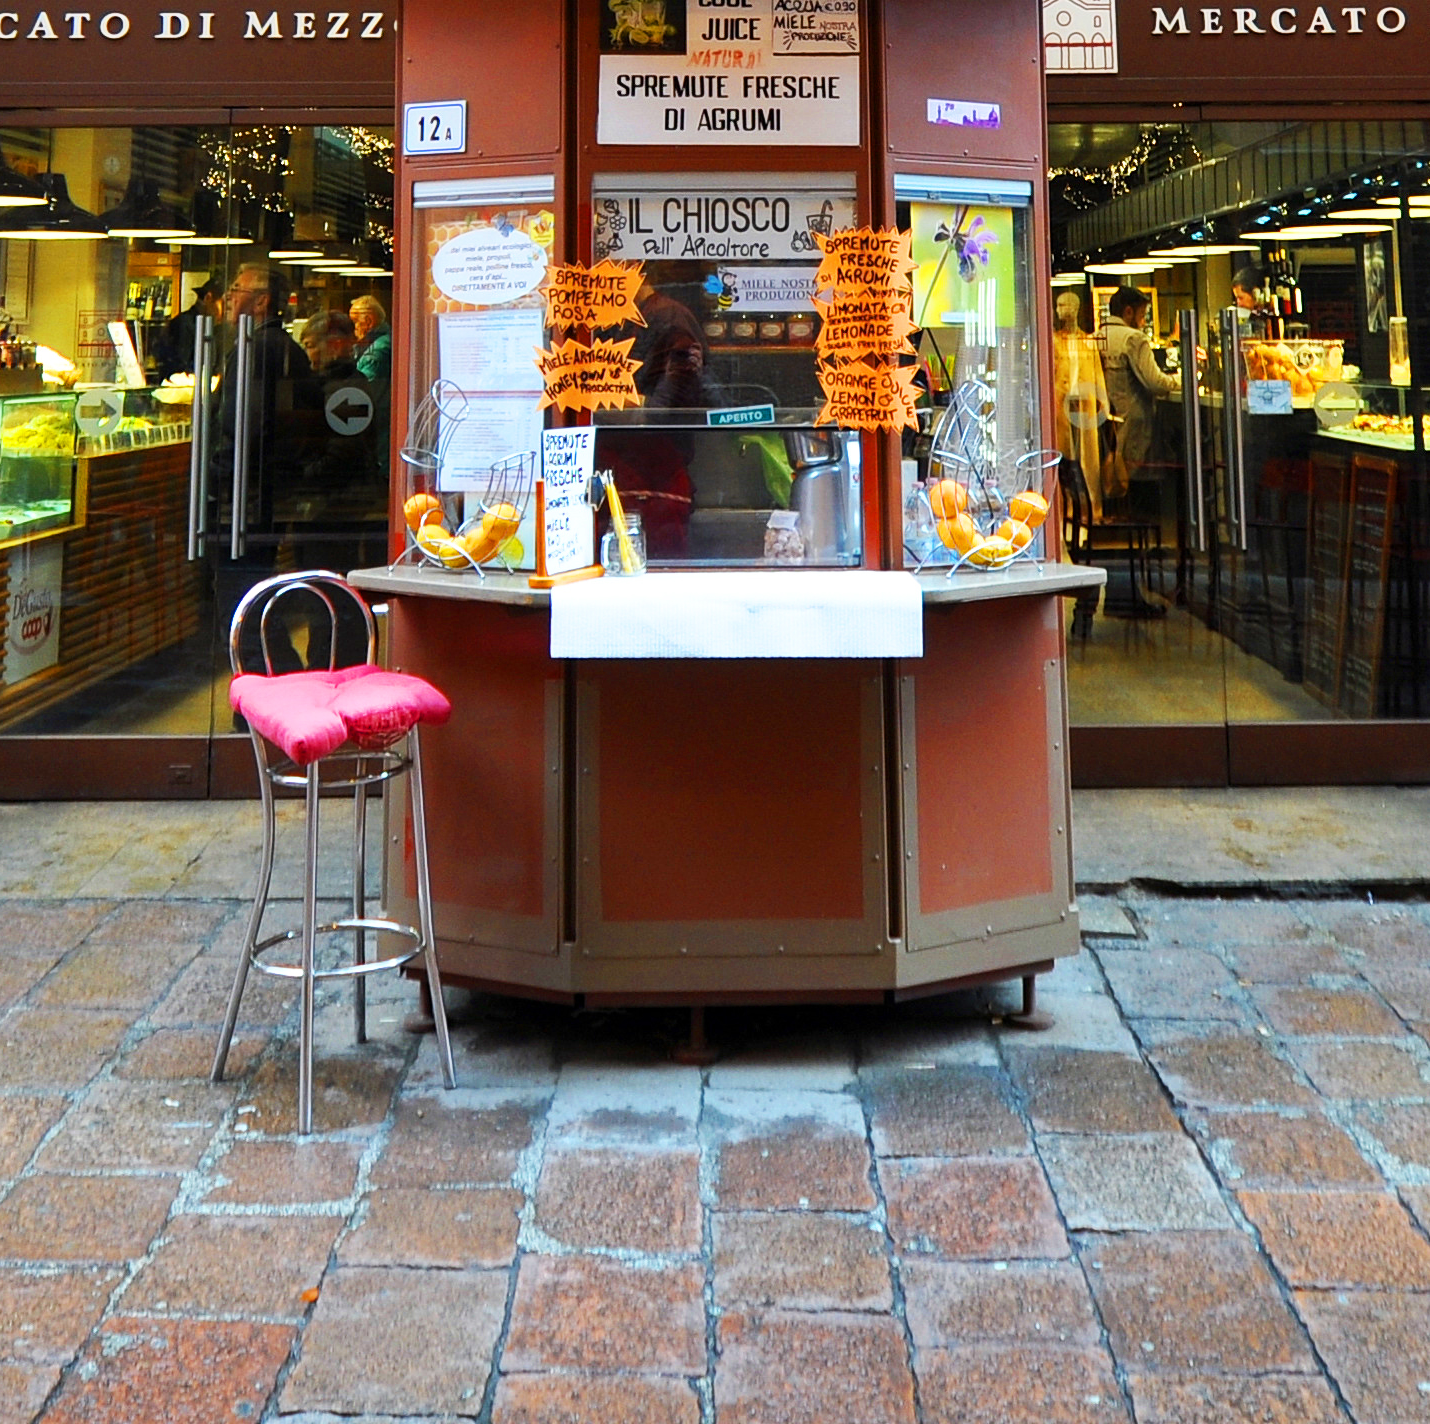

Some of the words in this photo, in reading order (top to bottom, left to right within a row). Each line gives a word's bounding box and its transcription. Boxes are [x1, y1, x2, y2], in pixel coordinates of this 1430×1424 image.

[154, 11, 216, 40] DI
[244, 10, 398, 40] MEZZ
[701, 17, 761, 41] JUICE
[773, 12, 816, 29] MIELE
[819, 20, 857, 32] NOSTRA
[1151, 5, 1406, 36] MERCATO
[616, 74, 729, 99] SPREMUTE
[742, 75, 840, 100] FRESCHE
[664, 108, 685, 132] DI
[697, 108, 781, 132] AGRUMI
[628, 197, 654, 234] IL
[662, 196, 790, 234] CHIOSCO
[825, 236, 901, 254] SPREMUTE
[840, 253, 899, 273] FRESCHE
[513, 281, 527, 289] VOI
[555, 270, 627, 291] SPREMUTE
[741, 278, 776, 289] MIELE
[821, 274, 832, 283] DI
[837, 267, 891, 287] AGRUMI
[548, 288, 627, 307] POMPELMO
[745, 290, 815, 301] PRODUZION
[553, 304, 598, 322] ROSA
[825, 323, 894, 342] LEMONADE
[580, 383, 633, 395] PRODUCTION
[825, 372, 877, 391] ORANGE
[831, 390, 876, 407] LEMON
[718, 411, 763, 424] APERTO
[829, 405, 898, 422] GRAPEFRUIT
[22, 616, 42, 641] coop
